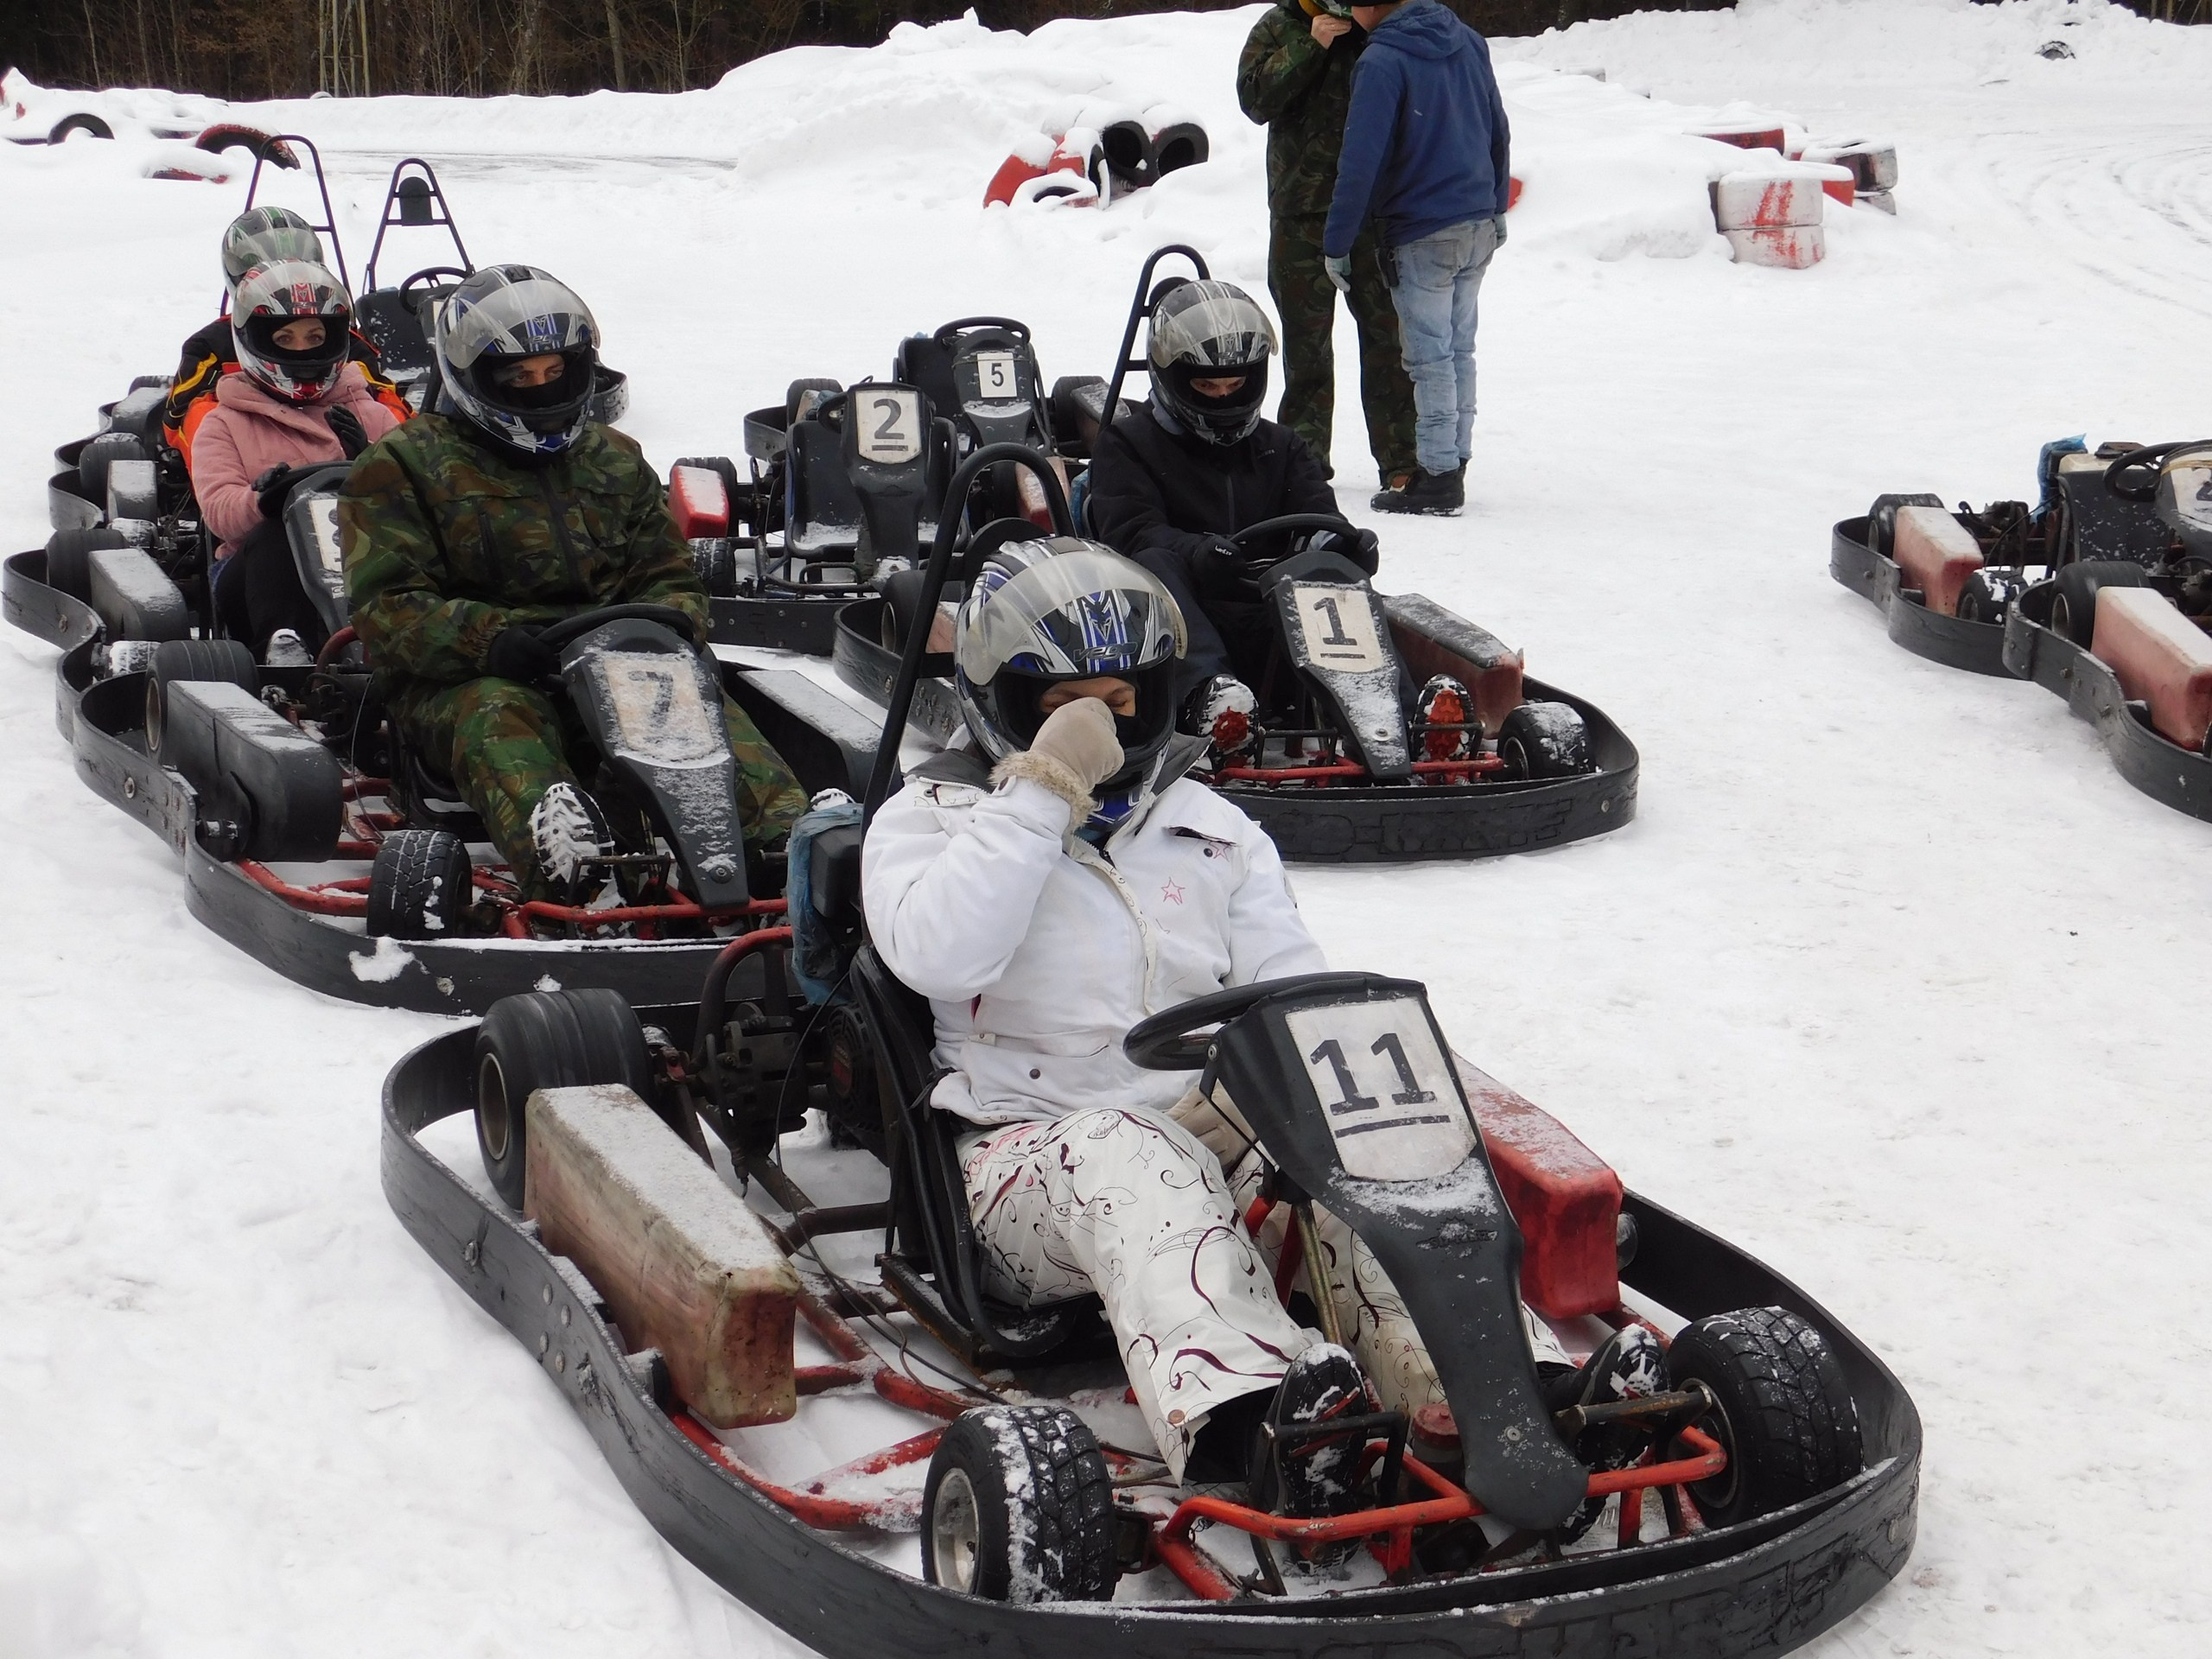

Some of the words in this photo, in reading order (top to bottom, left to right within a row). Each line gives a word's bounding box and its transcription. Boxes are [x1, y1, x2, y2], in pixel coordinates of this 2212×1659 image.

[991, 363, 1004, 387] 5
[874, 398, 905, 440] 2
[1313, 597, 1357, 646] 1
[627, 671, 674, 728] 7
[1309, 1033, 1436, 1116] 11
